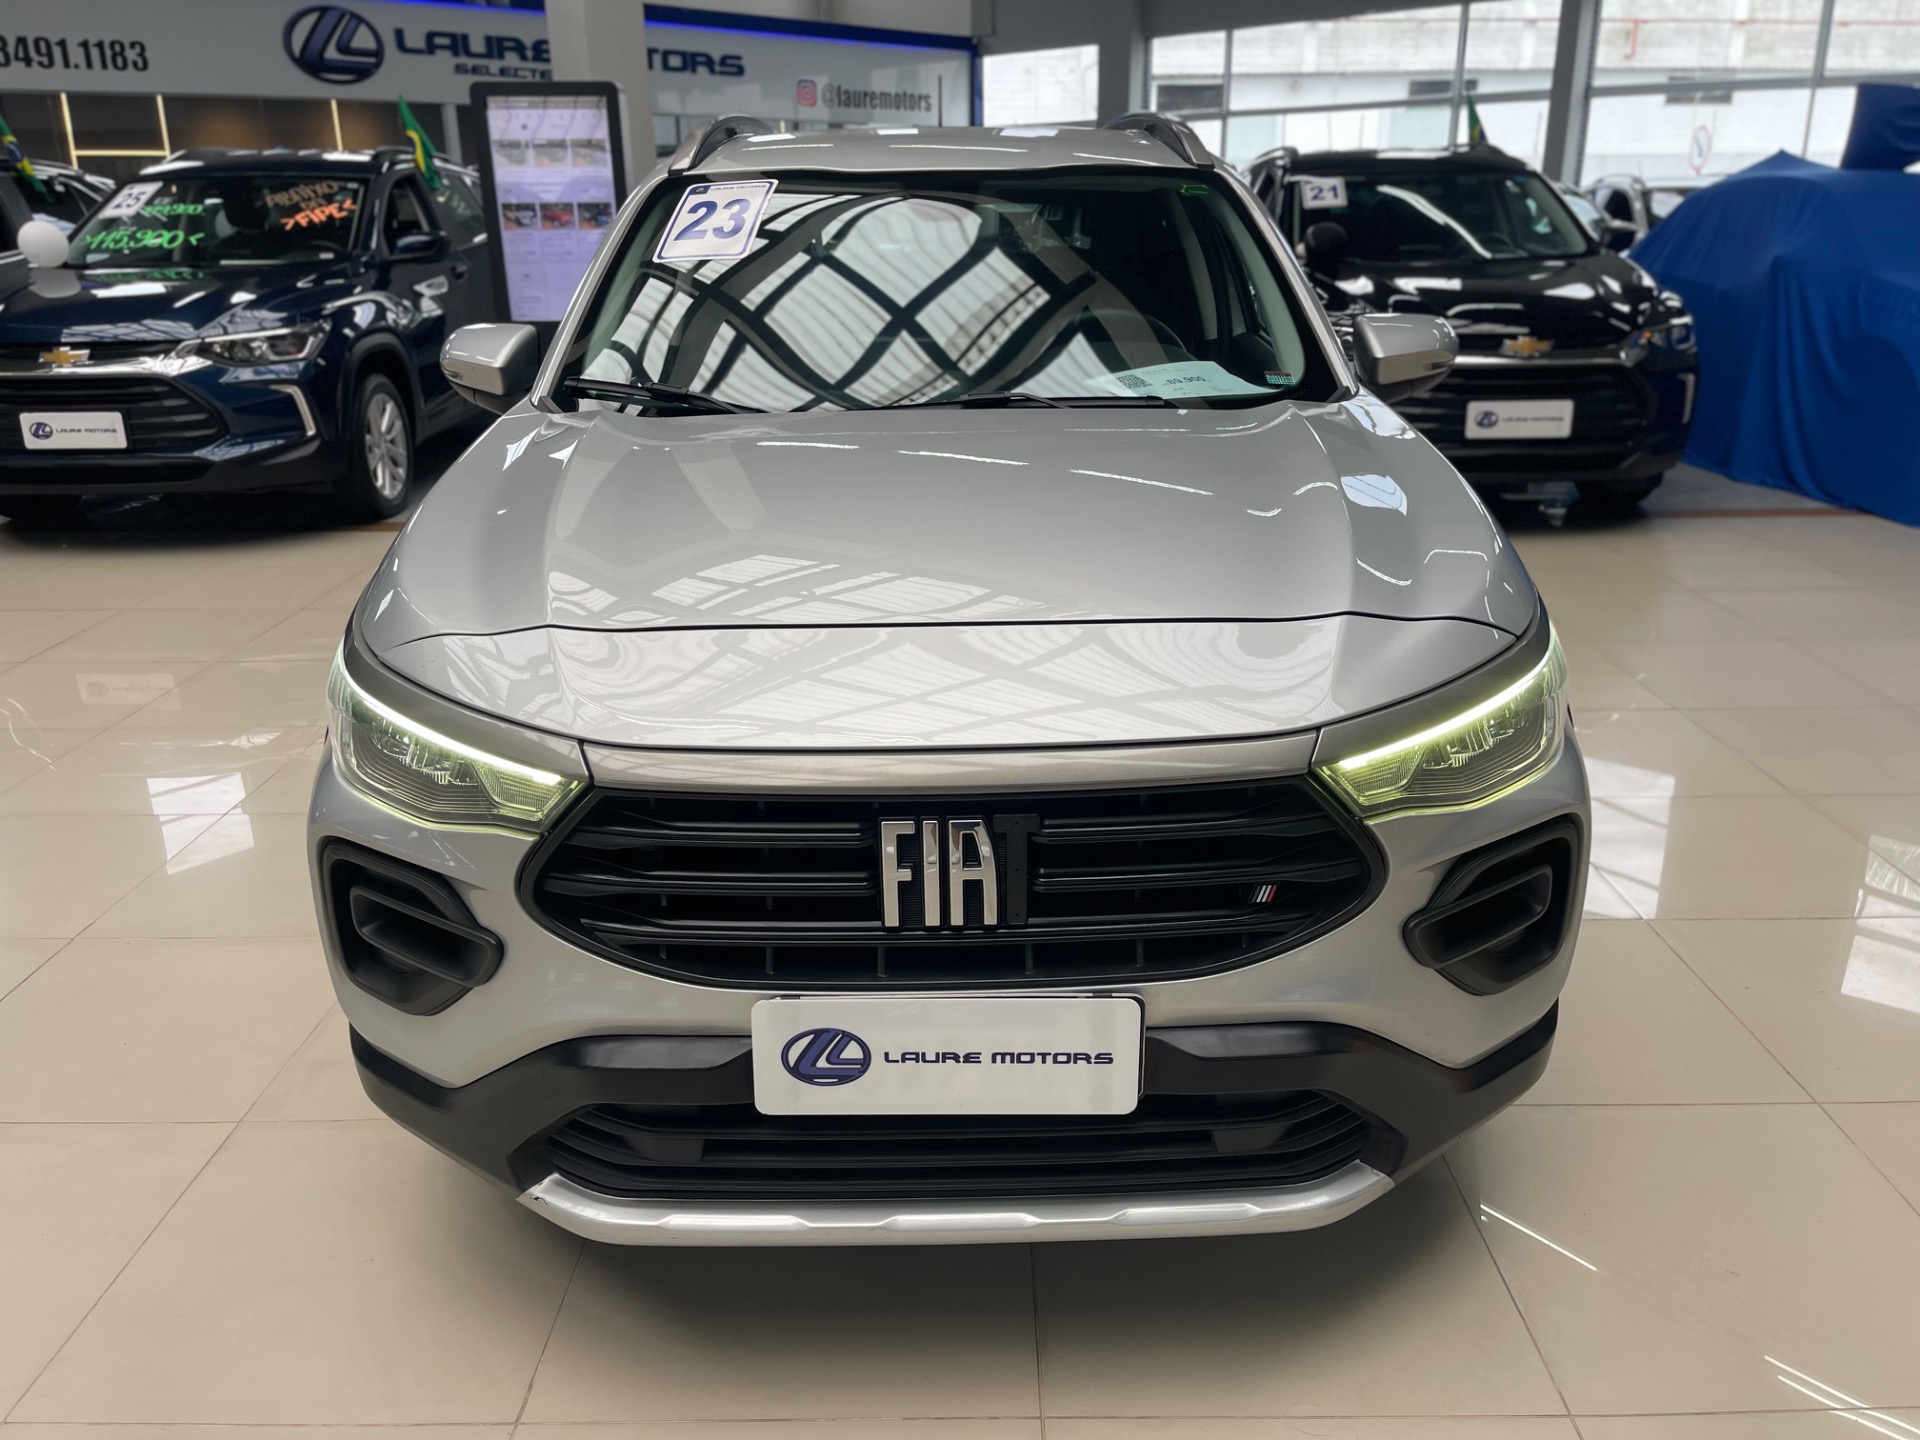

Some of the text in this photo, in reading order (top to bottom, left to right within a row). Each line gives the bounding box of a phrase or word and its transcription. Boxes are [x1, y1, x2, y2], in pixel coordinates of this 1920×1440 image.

[394, 28, 745, 77] LAURE TORS
[454, 63, 553, 81] SELECTE
[821, 82, 933, 113] @lauremotors
[1309, 185, 1339, 201] 21
[673, 198, 752, 242] 23
[878, 814, 1041, 933] FIAT
[884, 1051, 983, 1065] LAURE
[991, 1051, 1114, 1065] MOTORS
